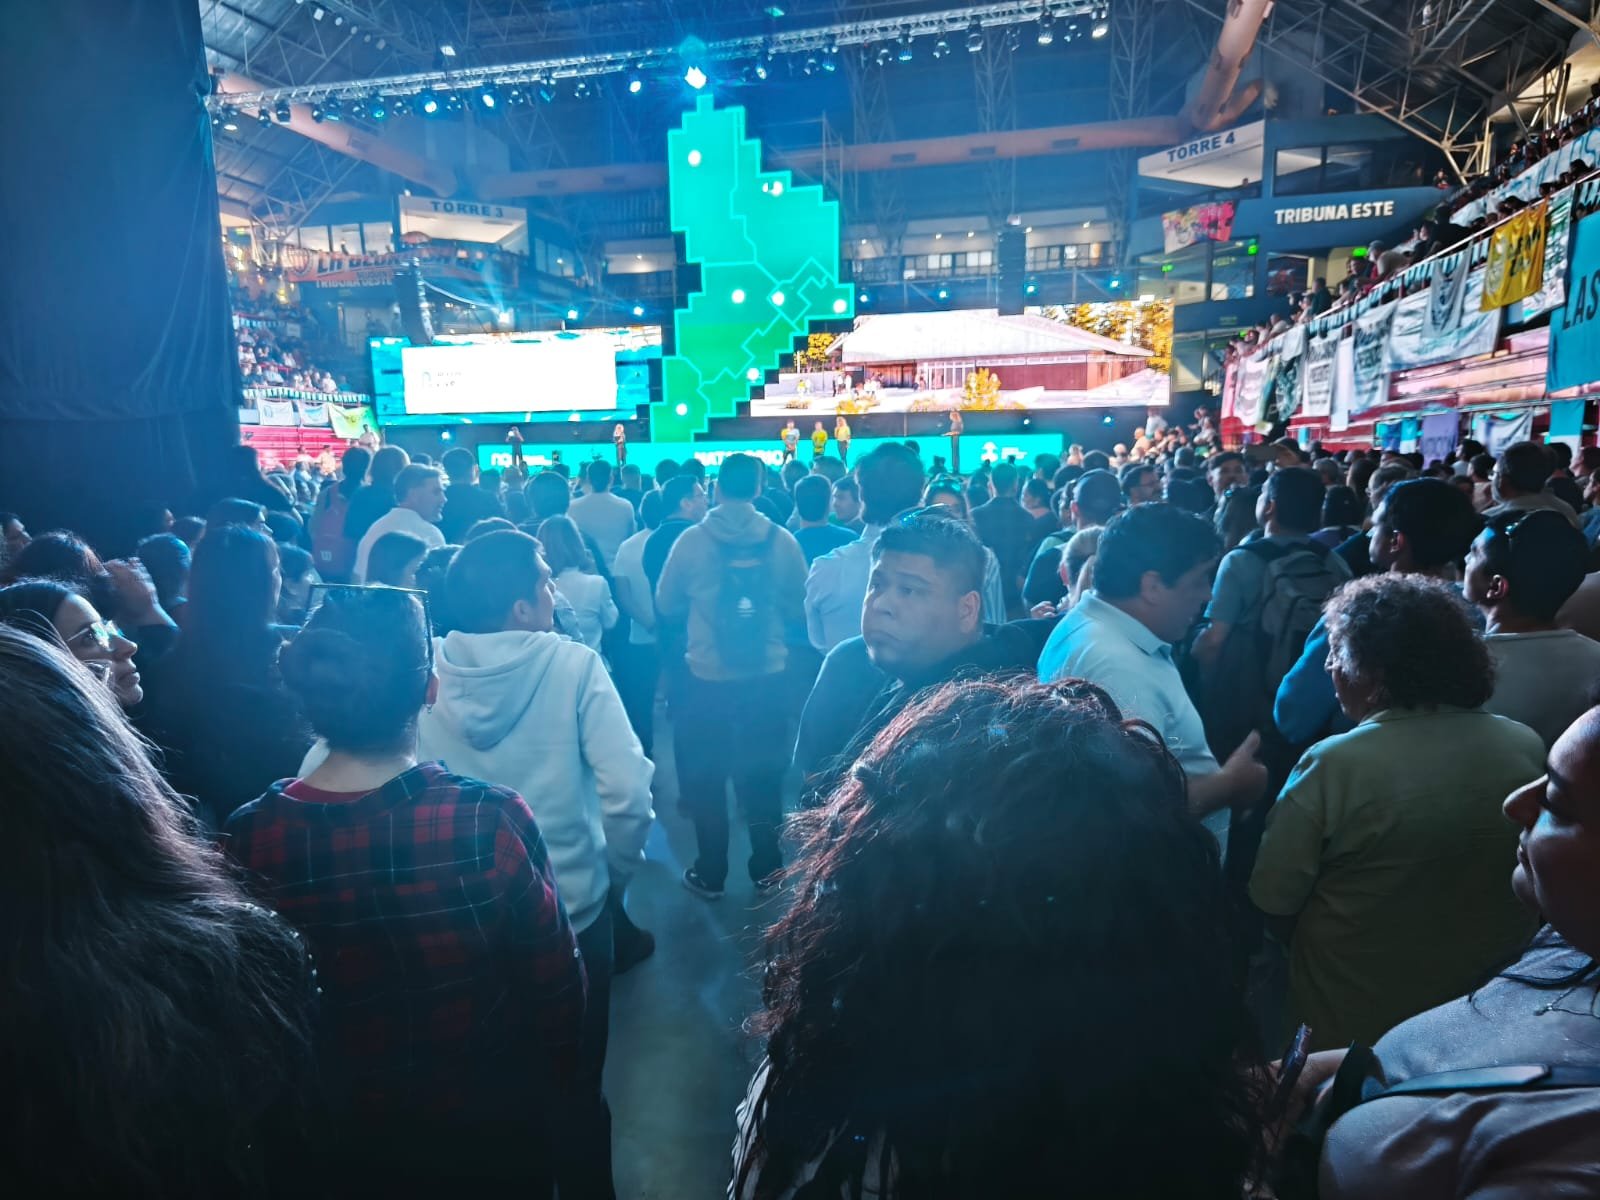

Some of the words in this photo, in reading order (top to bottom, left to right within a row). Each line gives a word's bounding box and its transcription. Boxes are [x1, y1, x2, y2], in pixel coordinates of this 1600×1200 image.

[1168, 136, 1222, 162] TORRE
[1225, 131, 1236, 145] 4
[431, 201, 491, 217] TORRE
[495, 207, 504, 218] 3
[1274, 204, 1349, 224] TRIBUNA
[1351, 200, 1395, 218] ESTE
